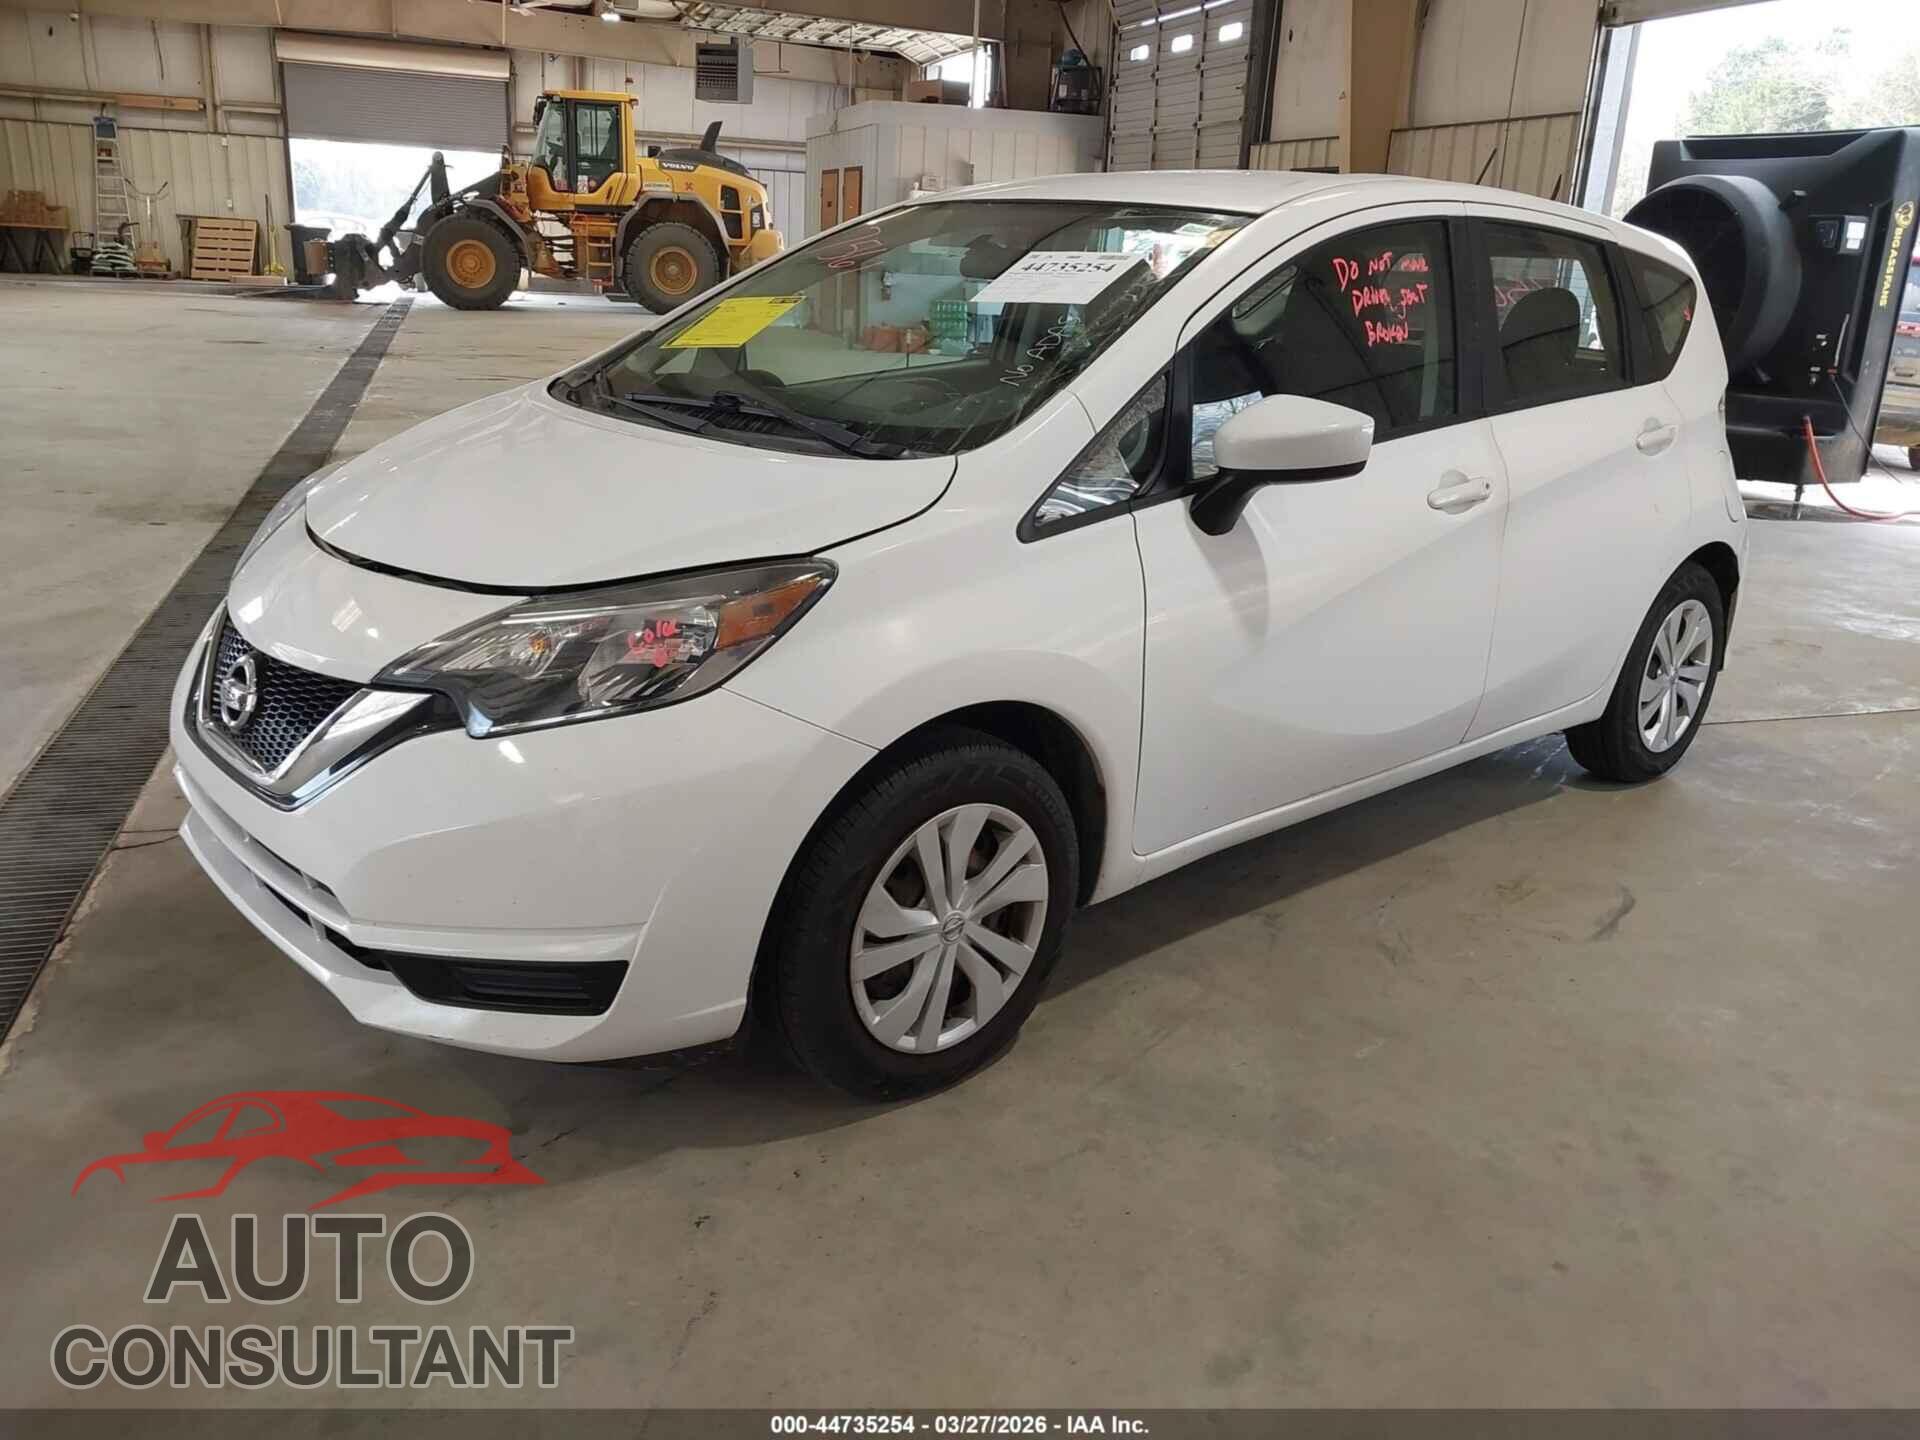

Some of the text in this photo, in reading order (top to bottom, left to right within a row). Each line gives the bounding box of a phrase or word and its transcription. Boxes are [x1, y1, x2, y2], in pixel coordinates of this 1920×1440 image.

[662, 162, 694, 170] VOLVO
[1020, 261, 1117, 273] 44735254
[1879, 227, 1903, 306] BIG ASS FANS
